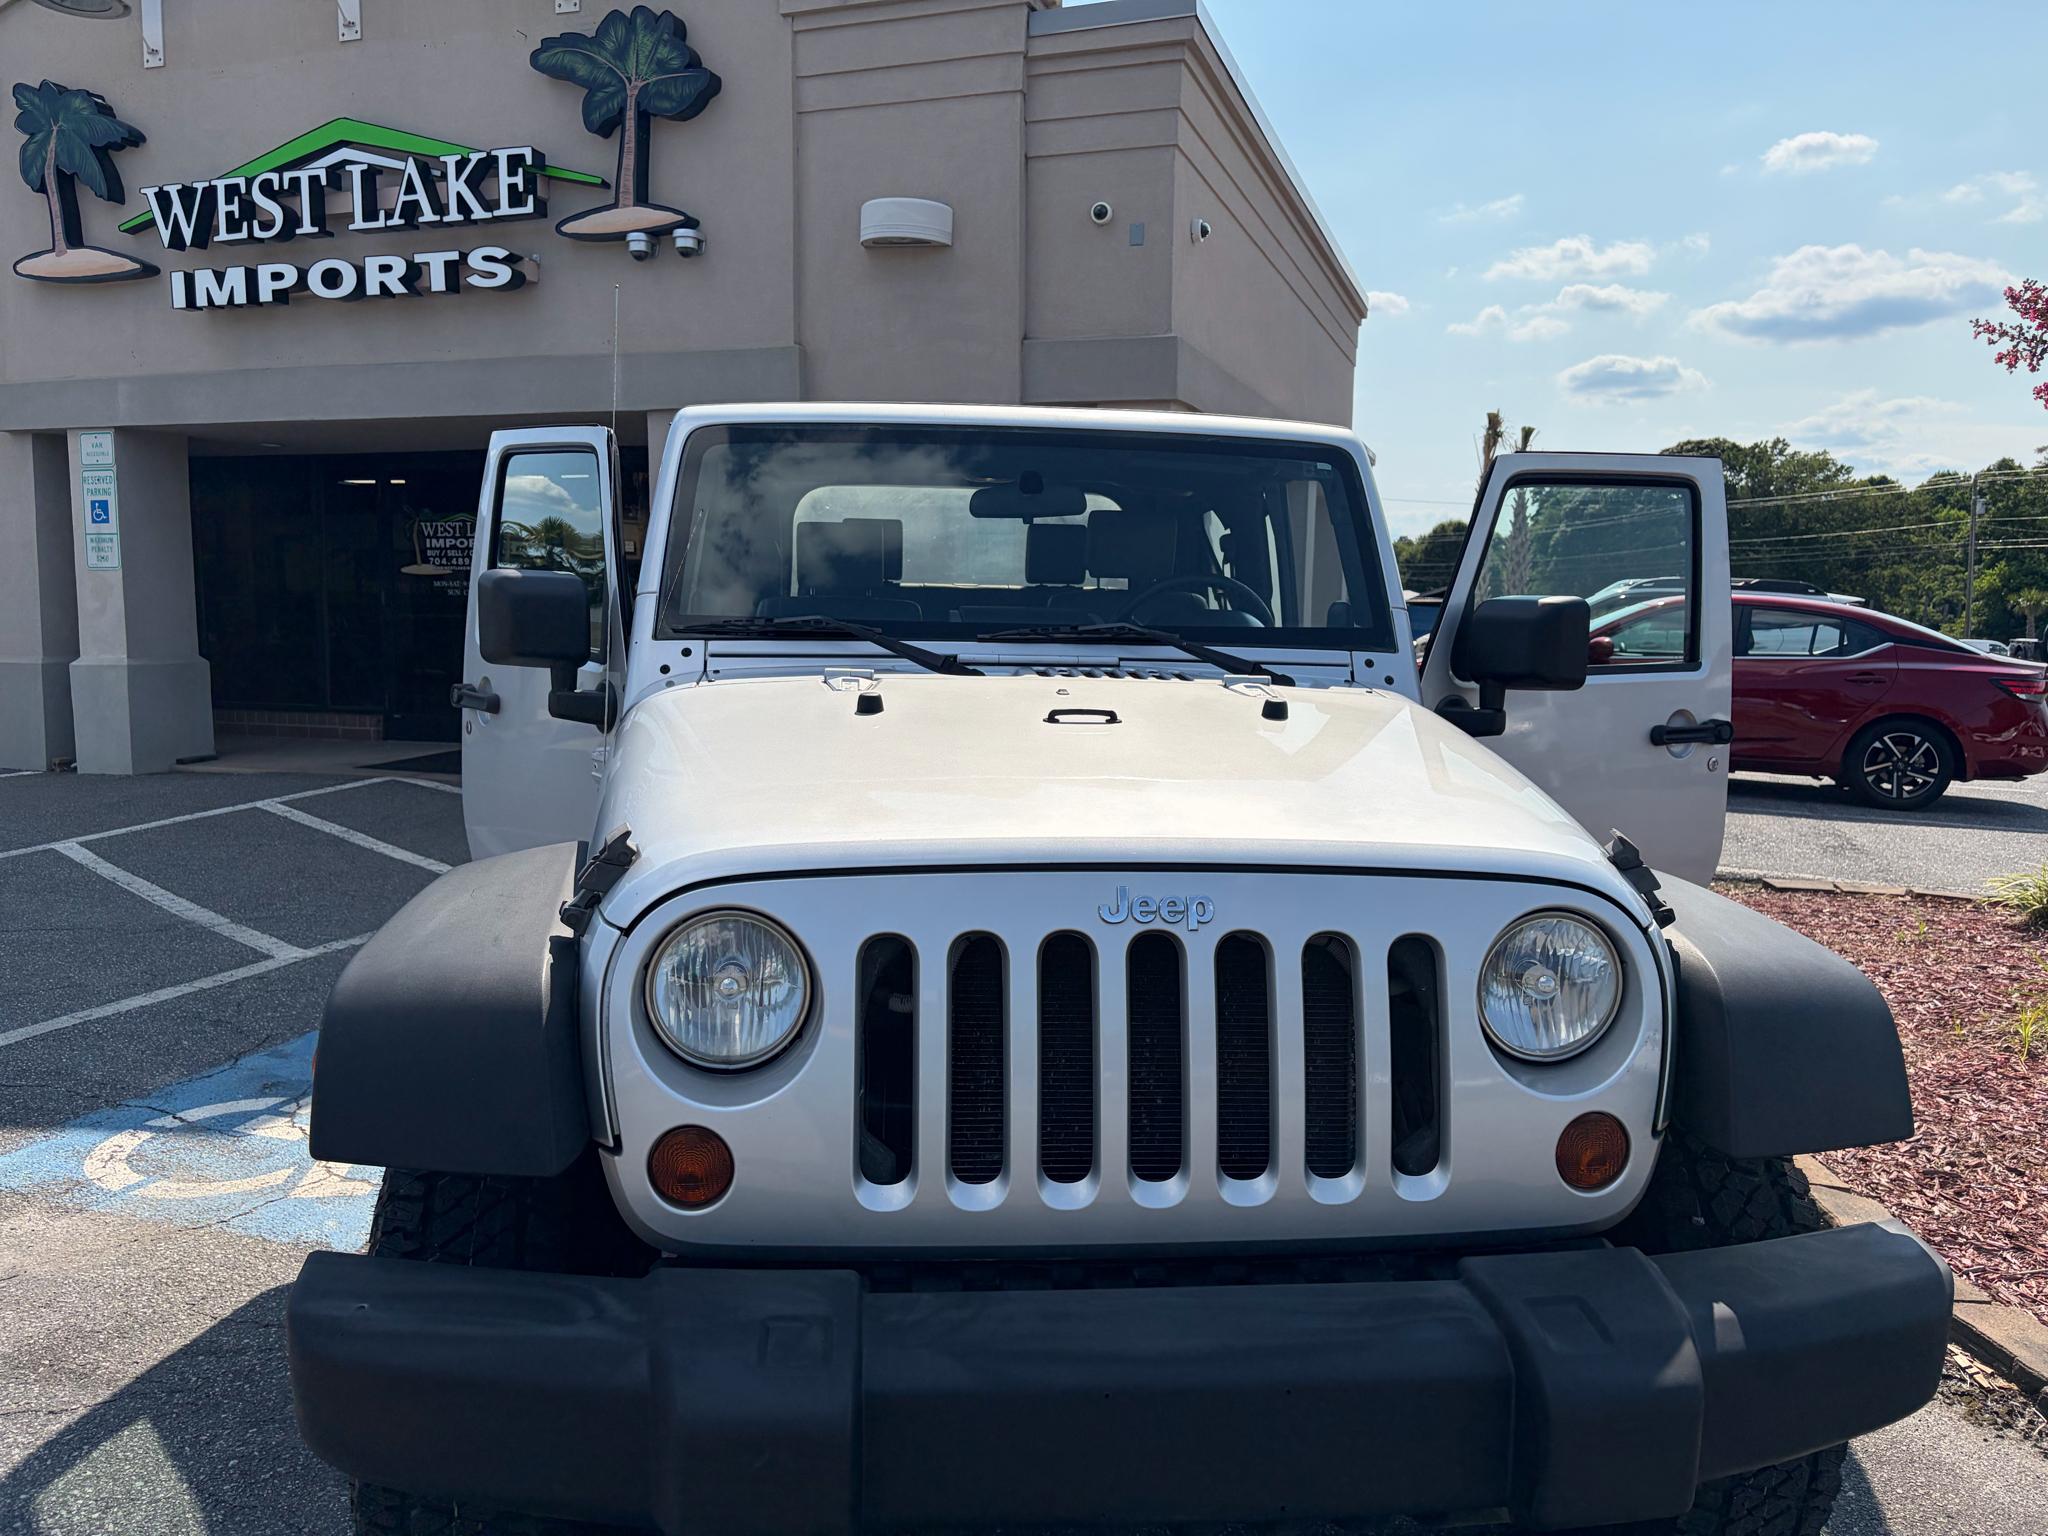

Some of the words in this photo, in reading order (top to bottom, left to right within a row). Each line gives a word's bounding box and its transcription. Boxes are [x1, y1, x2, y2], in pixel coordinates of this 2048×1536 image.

[140, 167, 328, 249] WEST
[345, 146, 535, 231] LAKE
[170, 246, 513, 309] IMPORTS
[83, 475, 113, 485] RESERVED
[86, 488, 112, 497] PARKING
[420, 522, 463, 537] WEST
[1098, 885, 1215, 931] Jeep
